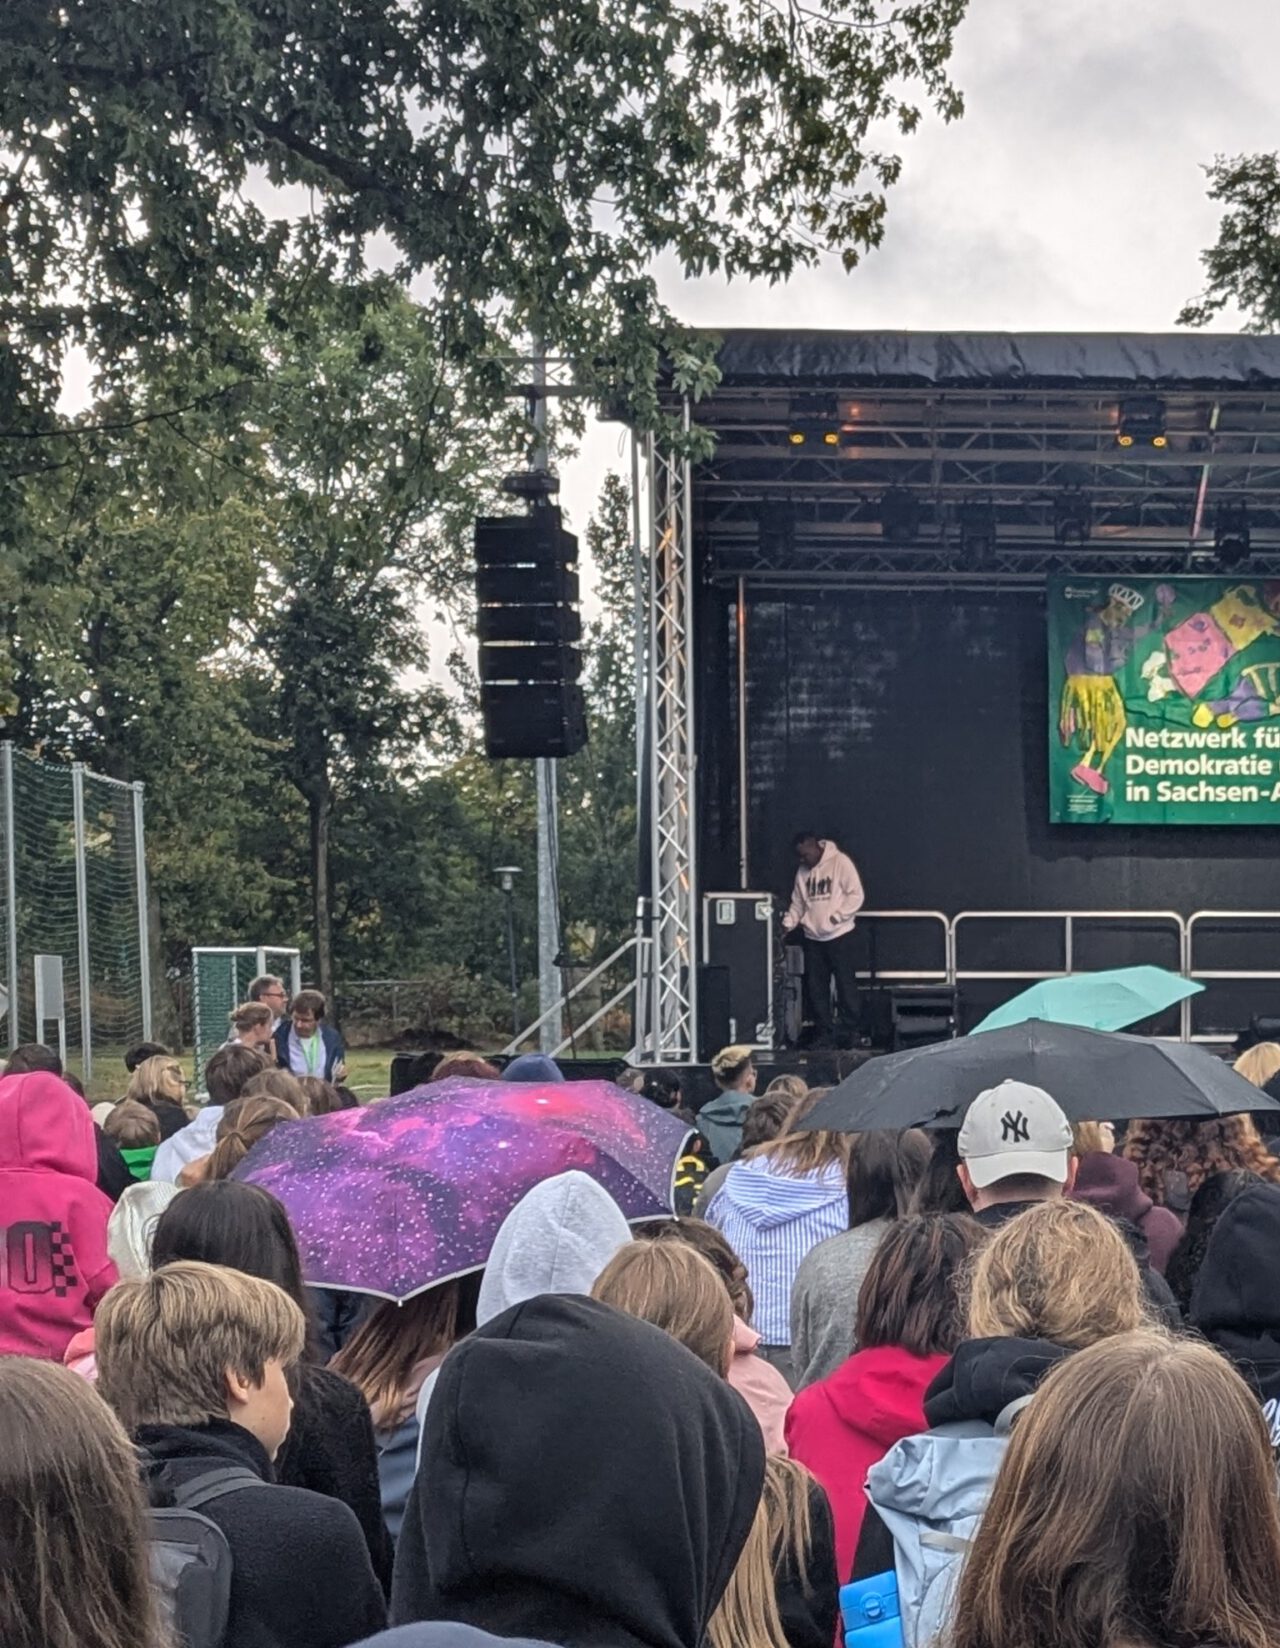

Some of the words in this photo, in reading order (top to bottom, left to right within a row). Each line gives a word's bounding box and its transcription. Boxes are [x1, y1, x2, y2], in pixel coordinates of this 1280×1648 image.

[1126, 727, 1247, 749] Netzwerk
[1126, 753, 1273, 776] Demokratie
[1126, 780, 1150, 802] in
[1000, 1110, 1031, 1143] NY
